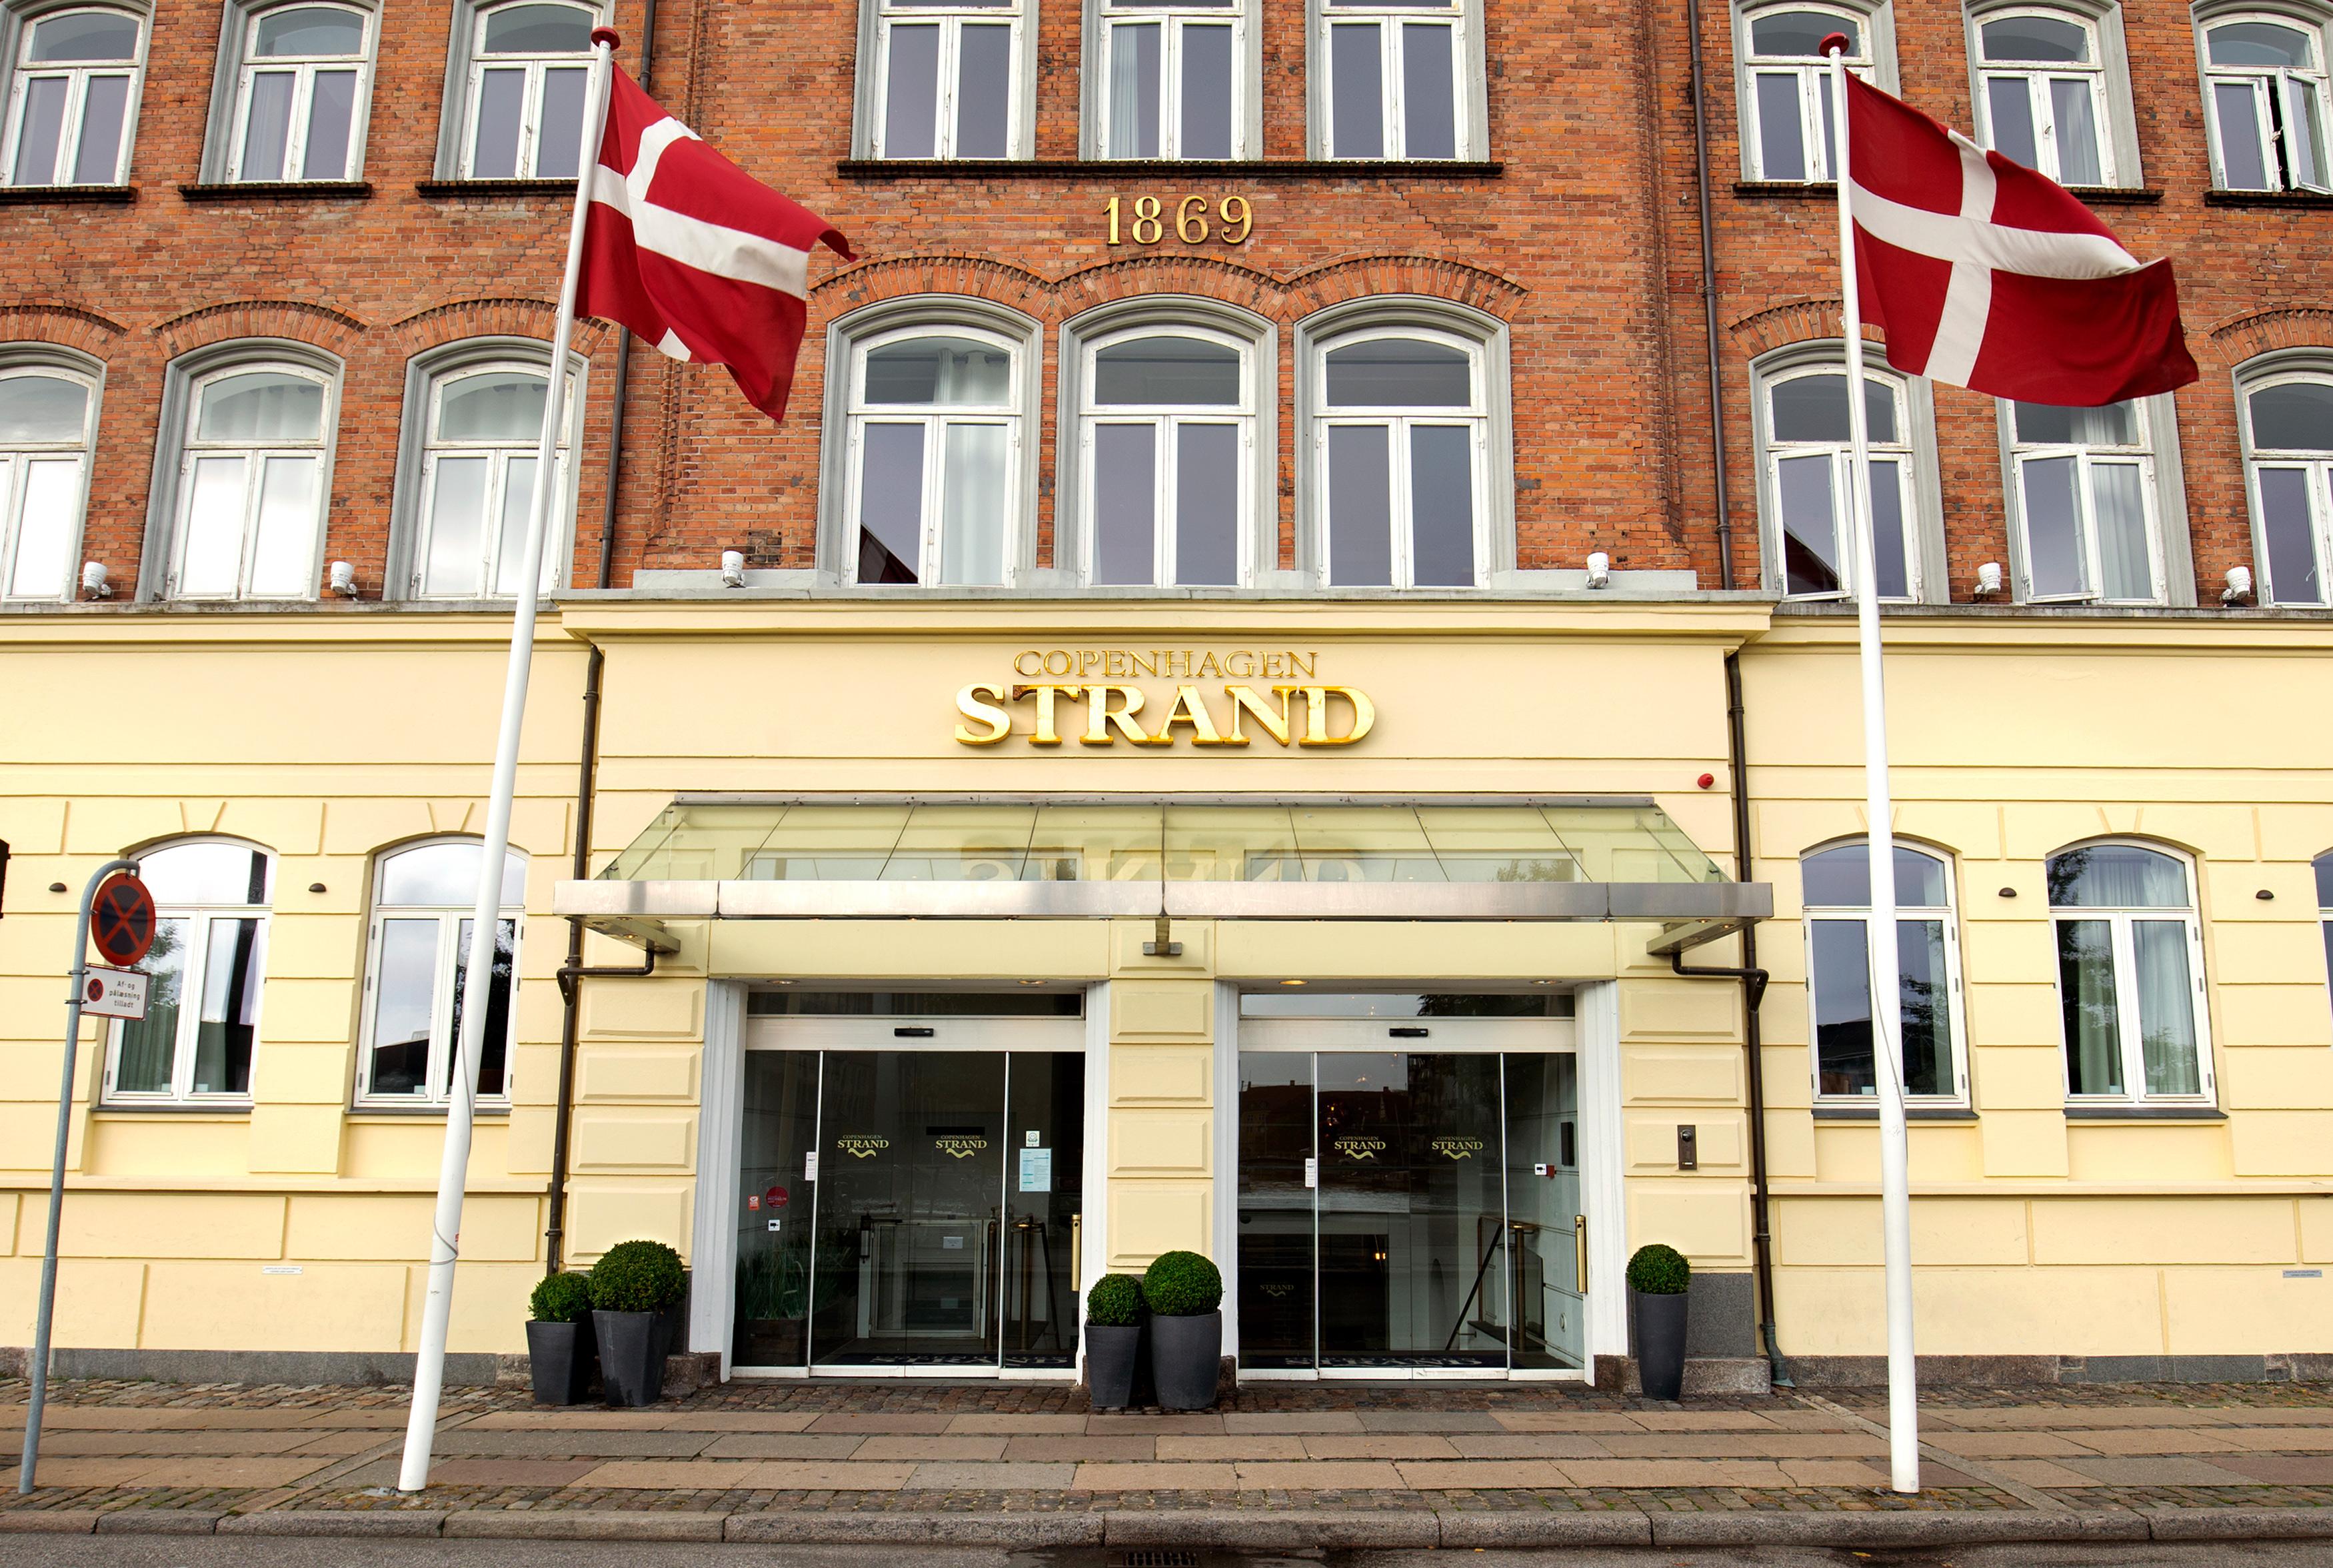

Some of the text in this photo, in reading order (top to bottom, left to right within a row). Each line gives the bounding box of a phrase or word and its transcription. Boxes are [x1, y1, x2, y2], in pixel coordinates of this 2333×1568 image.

[1103, 195, 1252, 245] 1869
[1013, 650, 1320, 678] COPENHAGEN
[955, 682, 1376, 746] STRAND
[109, 990, 140, 1000] pålæsning
[837, 1140, 889, 1148] STRAND
[935, 1140, 988, 1149] STRAND
[1334, 1141, 1386, 1150] STRAND
[1432, 1141, 1484, 1150] STRAND
